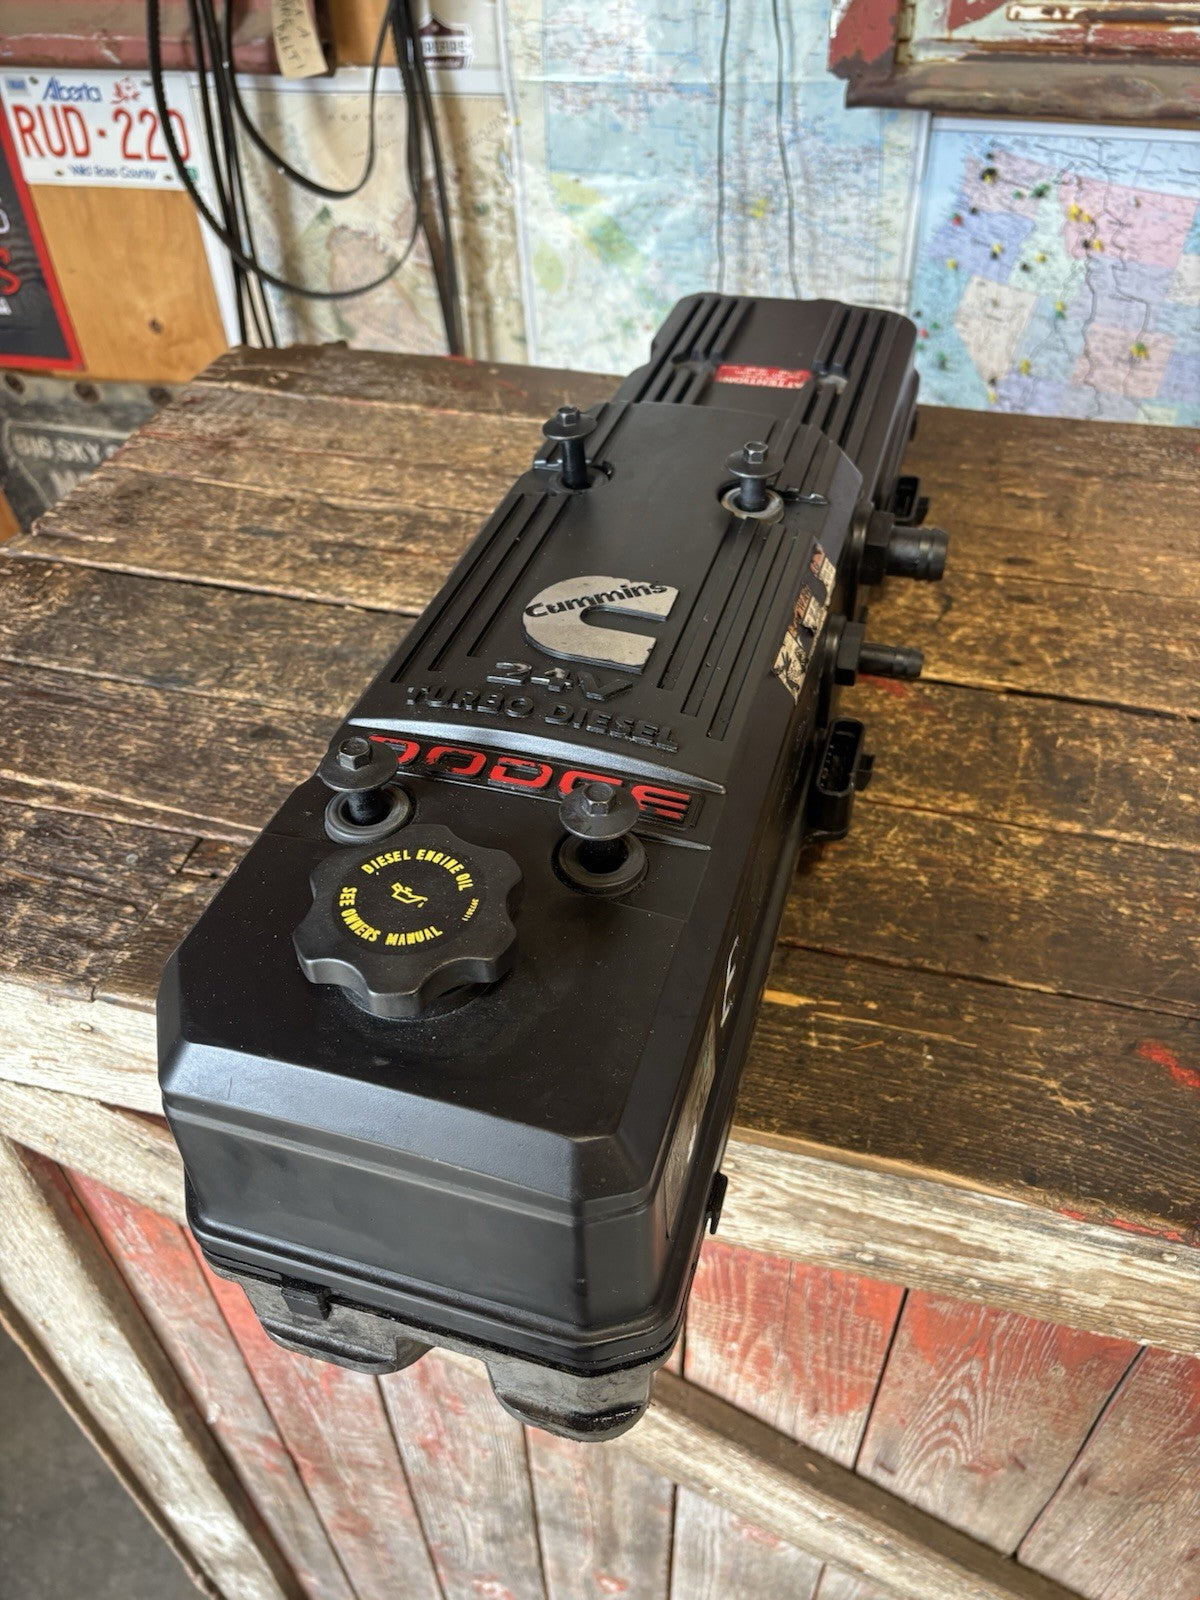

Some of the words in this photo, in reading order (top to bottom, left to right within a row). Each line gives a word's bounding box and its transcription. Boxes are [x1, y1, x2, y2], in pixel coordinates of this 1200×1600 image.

[43, 76, 103, 103] Alberta
[523, 581, 668, 618] Cummins
[486, 661, 634, 702] 24V
[405, 684, 535, 718] TURBO
[544, 702, 679, 753] DIESEL
[361, 849, 411, 875] DIESEL
[415, 848, 464, 875] ENGINE
[455, 872, 474, 892] OIL
[338, 886, 358, 907] SEE
[340, 908, 382, 943] OWNERS
[385, 925, 443, 946] MANUAL
